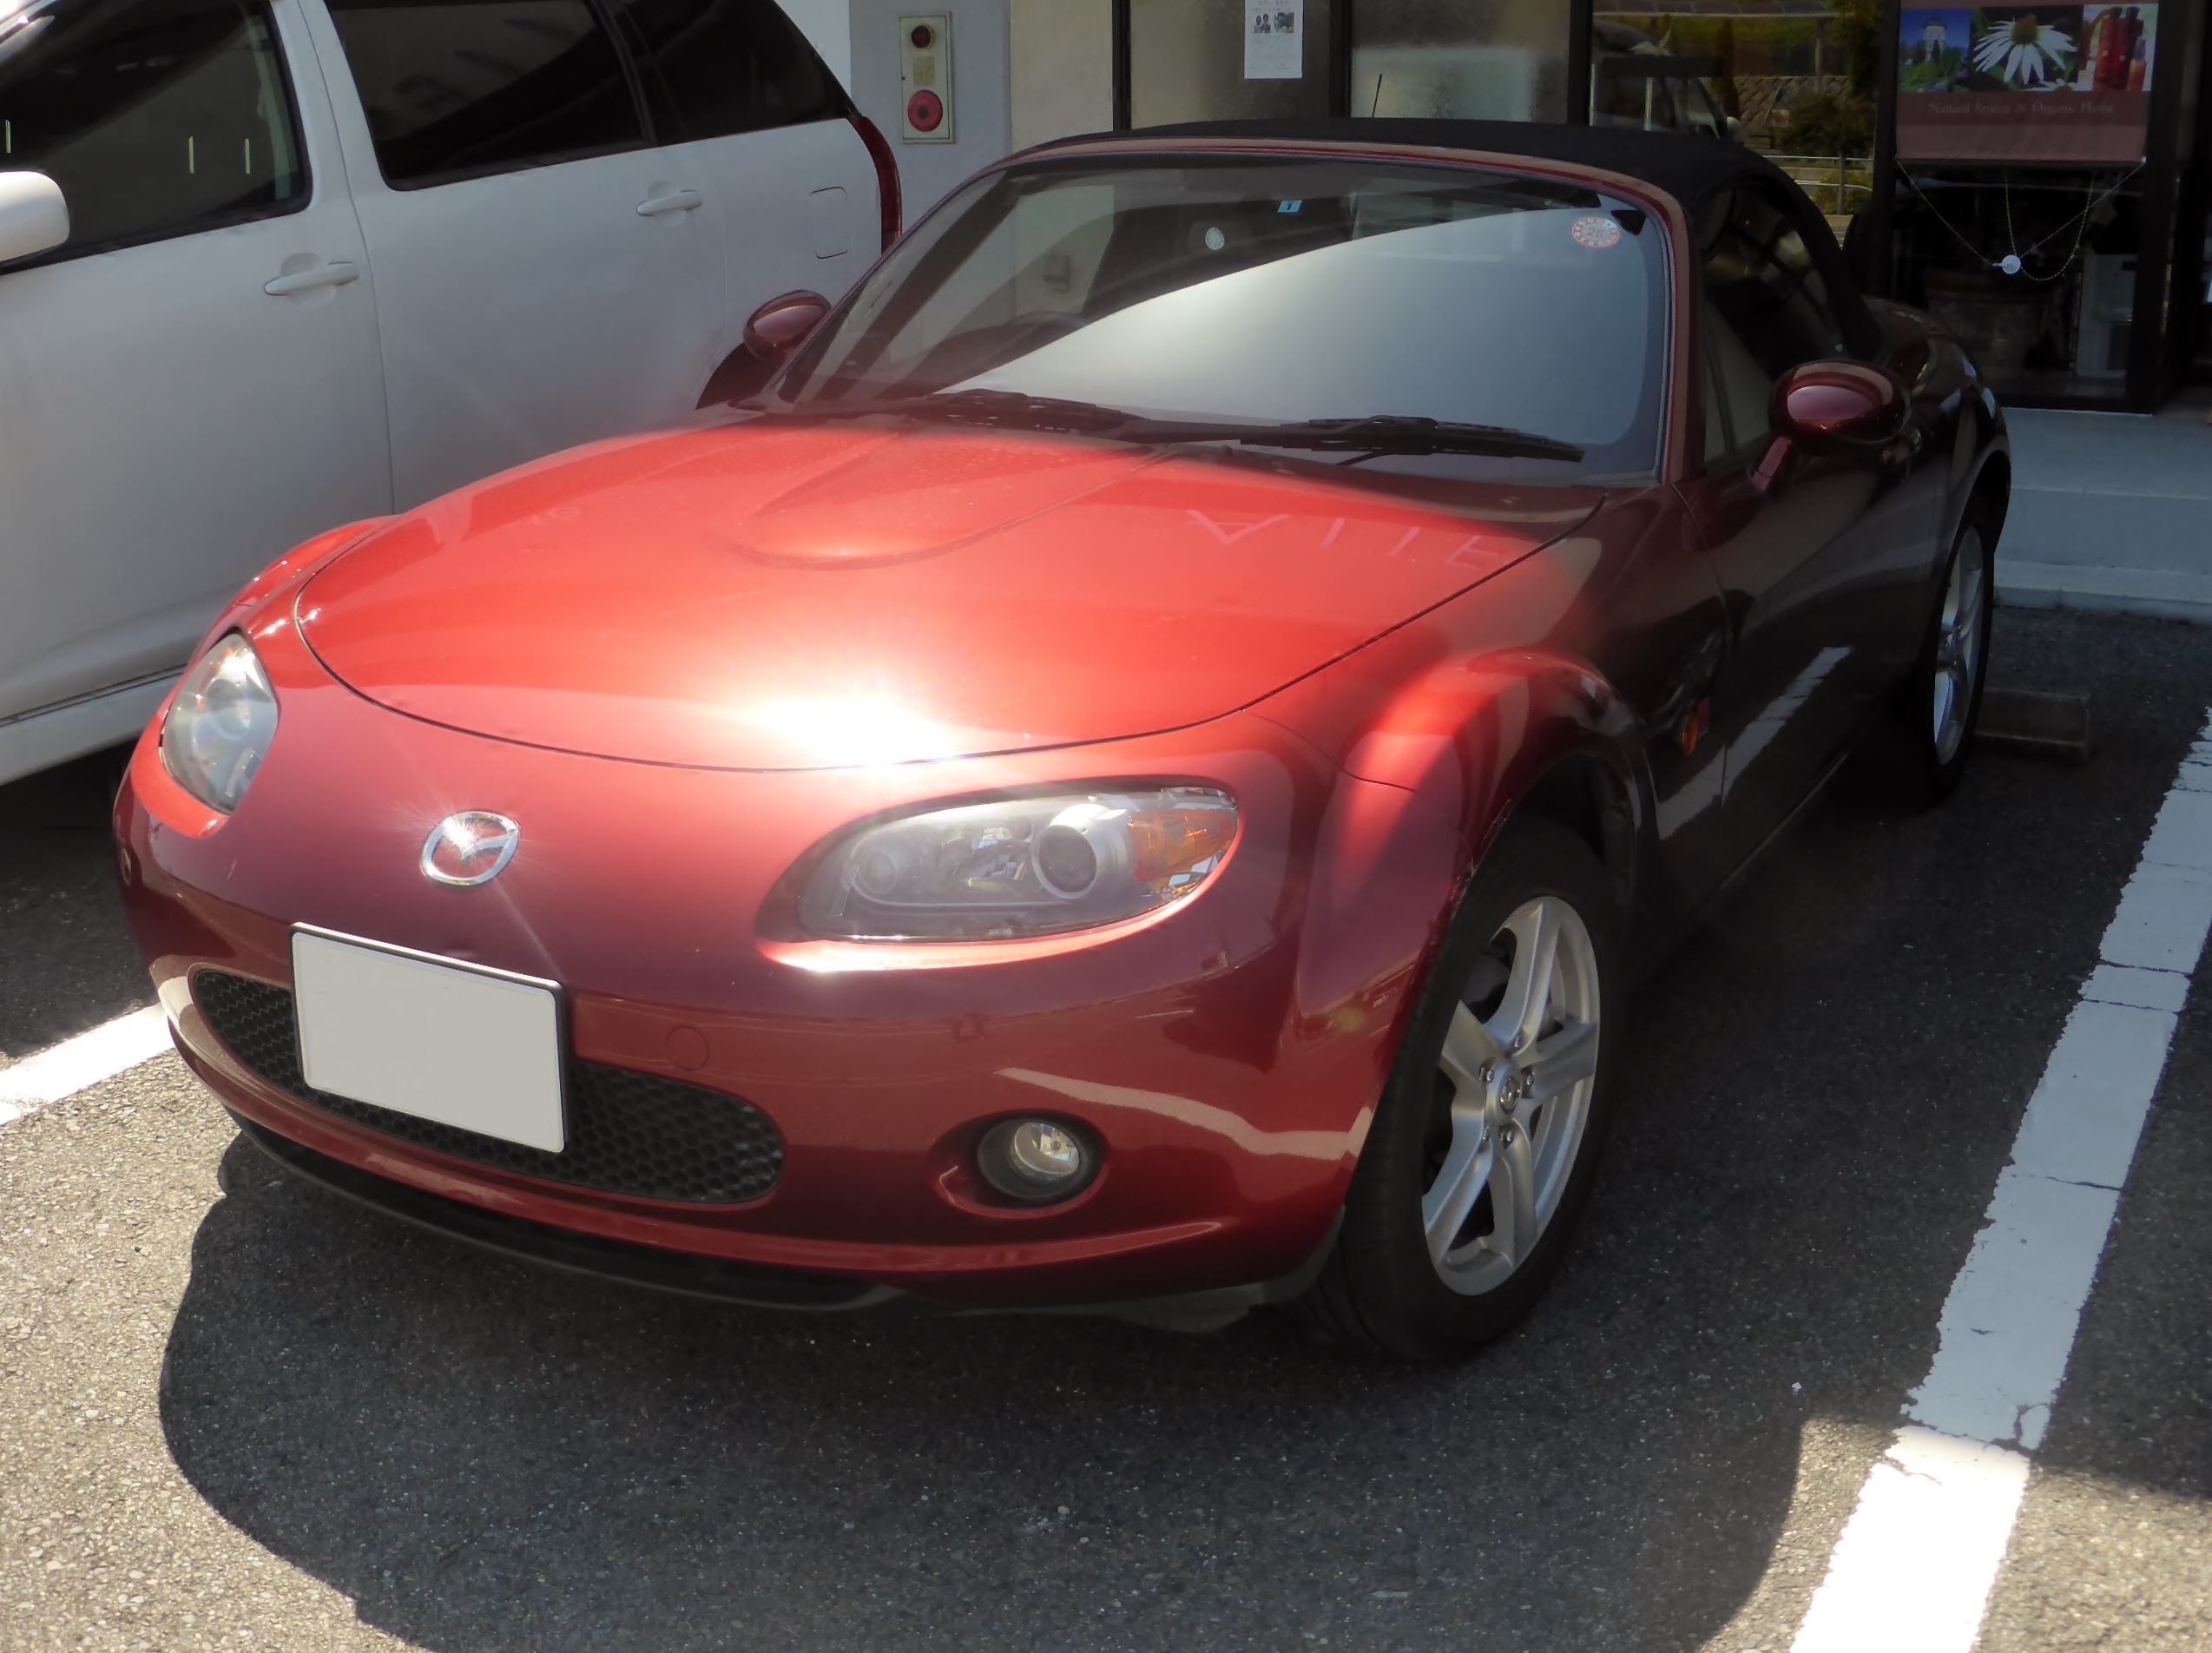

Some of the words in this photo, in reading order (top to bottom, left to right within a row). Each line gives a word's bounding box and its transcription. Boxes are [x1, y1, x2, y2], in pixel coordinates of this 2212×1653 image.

[1928, 102, 1970, 113] Natural
[1973, 102, 2010, 113] Aroma
[2015, 102, 2025, 113] &
[2031, 101, 2076, 115] Organic
[2080, 101, 2114, 113] Herbs
[1586, 228, 1603, 238] 26
